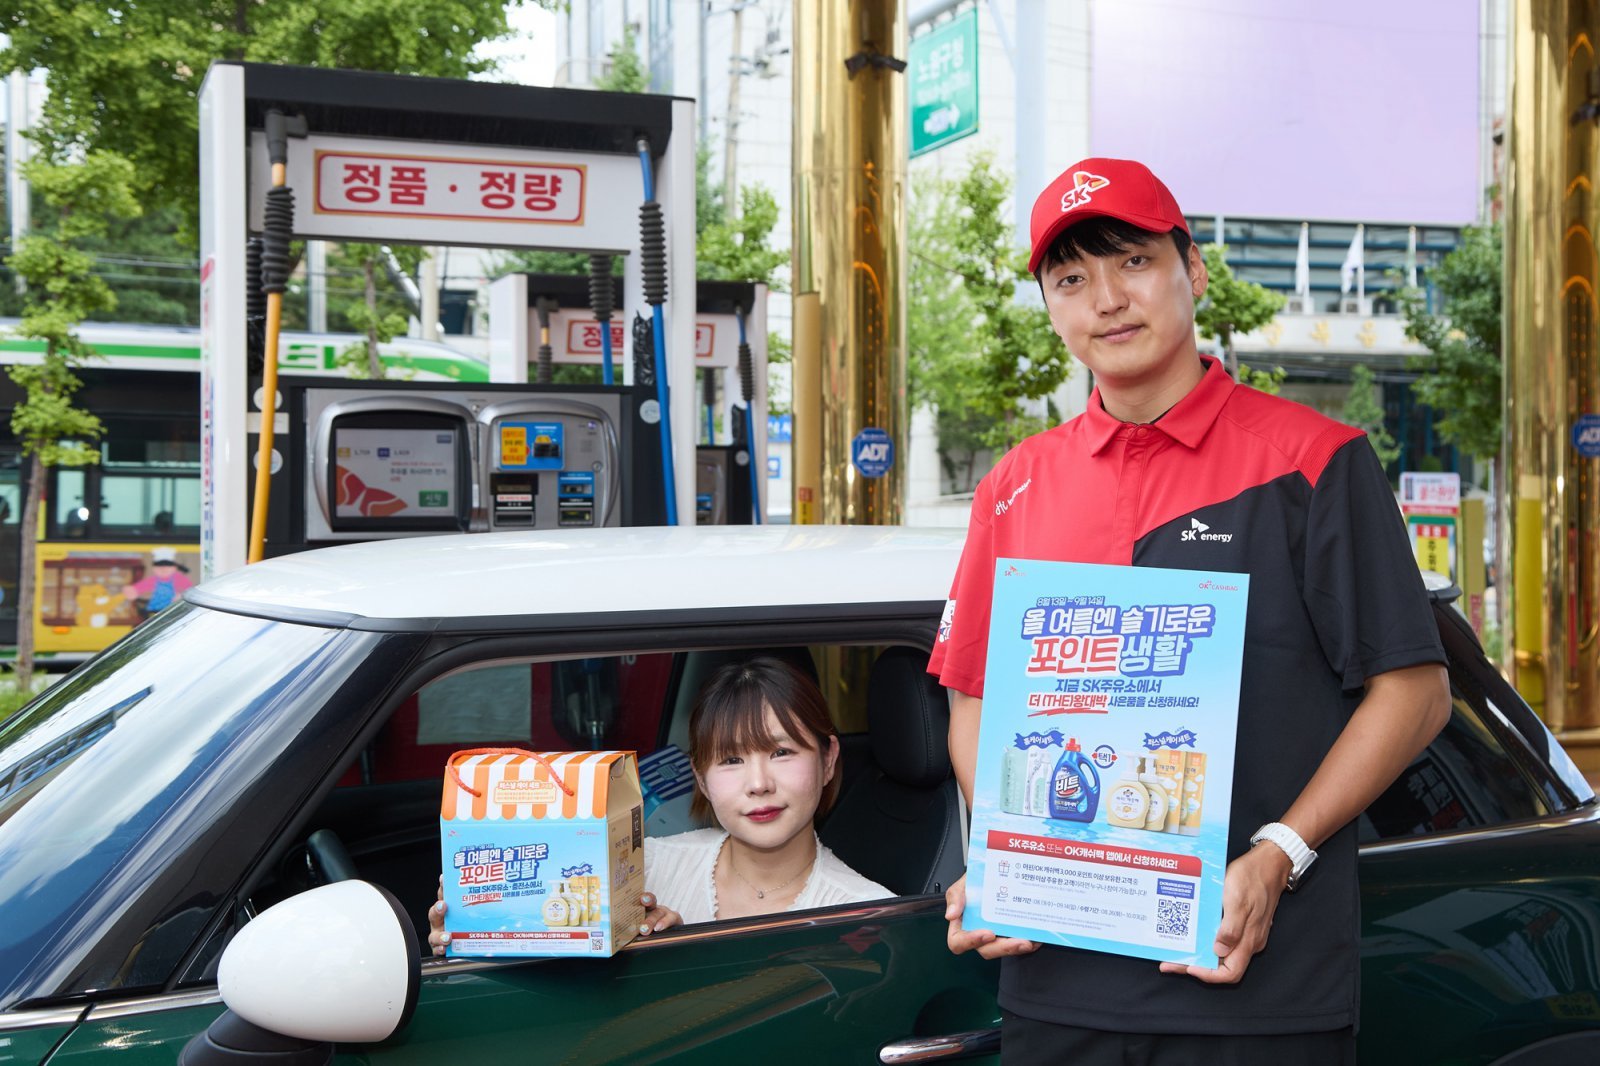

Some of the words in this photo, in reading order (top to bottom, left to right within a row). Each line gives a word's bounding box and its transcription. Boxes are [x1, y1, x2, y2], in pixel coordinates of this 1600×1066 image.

[343, 163, 427, 205] 정품
[480, 172, 562, 212] 정량
[1062, 187, 1089, 210] SK
[858, 444, 889, 461] ADT
[1181, 529, 1197, 541] SK
[1200, 533, 1233, 543] energy
[1022, 608, 1046, 635] 올
[1049, 607, 1116, 634] 여름엔
[1120, 605, 1211, 634] 슬기로운
[1055, 679, 1080, 692] 지금
[1082, 679, 1162, 693] SK주유소에서
[1108, 696, 1146, 707] 사은품을
[1148, 696, 1199, 708] 신청하세요!
[1055, 775, 1080, 792] 비트
[454, 851, 466, 867] 올
[467, 848, 501, 865] 여름엔
[503, 844, 547, 862] 슬기로운
[1008, 838, 1046, 852] SK주유소
[1046, 843, 1063, 855] 또는
[1064, 846, 1105, 860] OK캐쉬백
[1106, 851, 1132, 864] 앱에서
[1132, 854, 1178, 869] 신청하세요!
